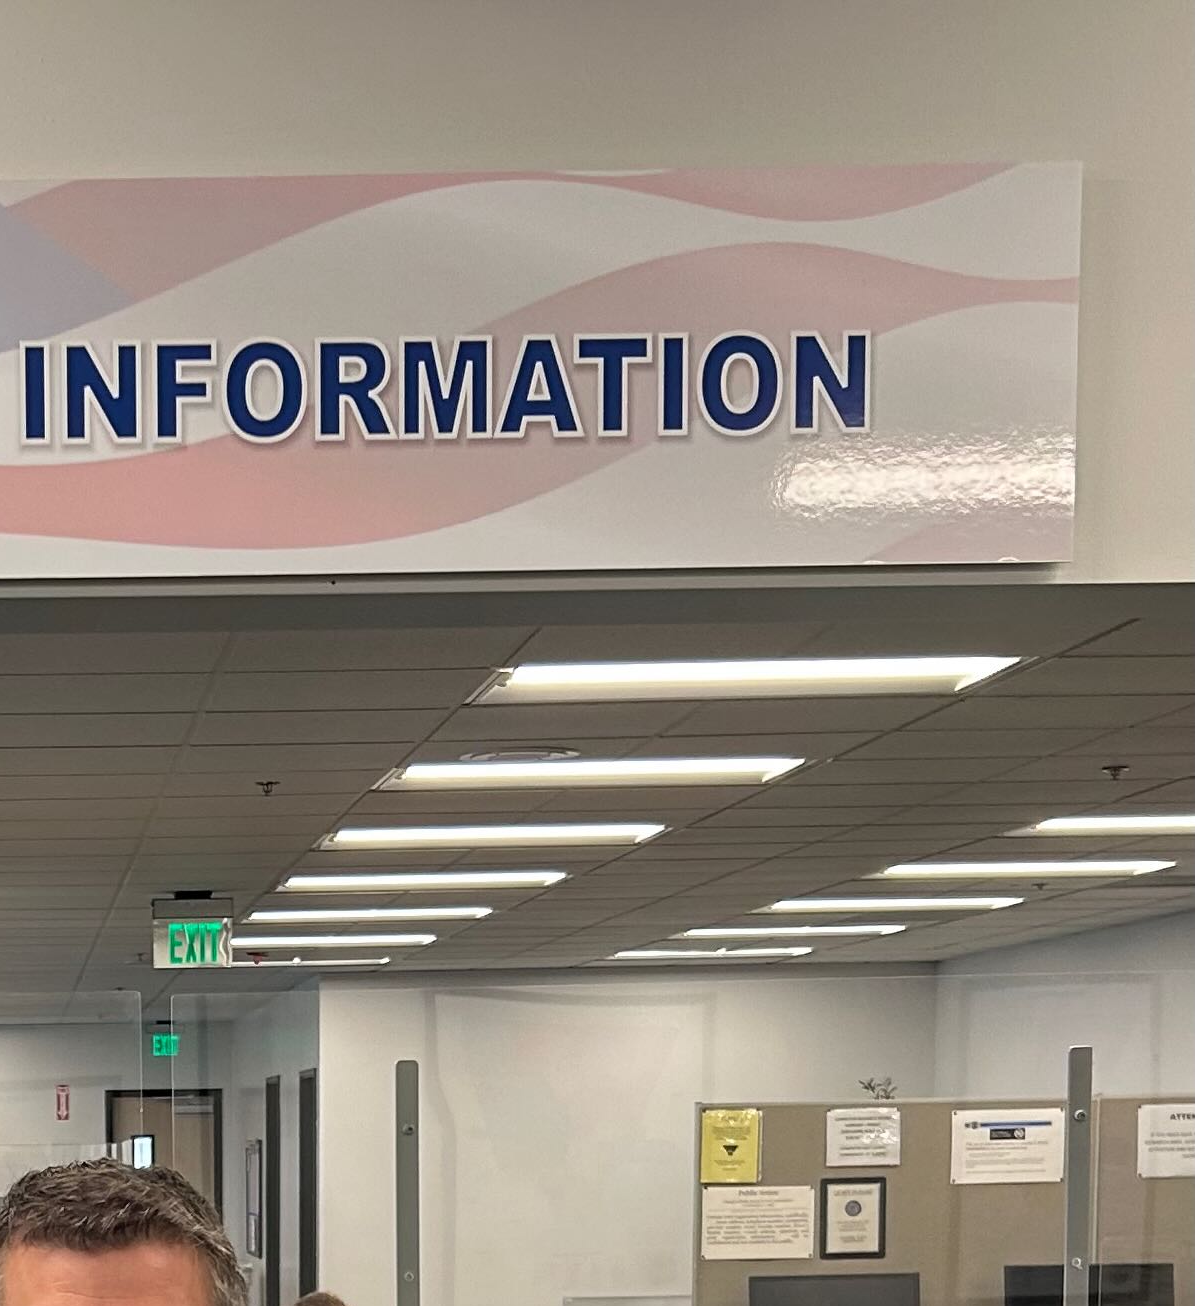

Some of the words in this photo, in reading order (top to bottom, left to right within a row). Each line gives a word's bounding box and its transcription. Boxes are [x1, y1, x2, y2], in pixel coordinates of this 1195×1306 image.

[21, 331, 872, 446] INFORMATION
[168, 923, 222, 963] EXIT
[153, 1036, 179, 1055] EXIT
